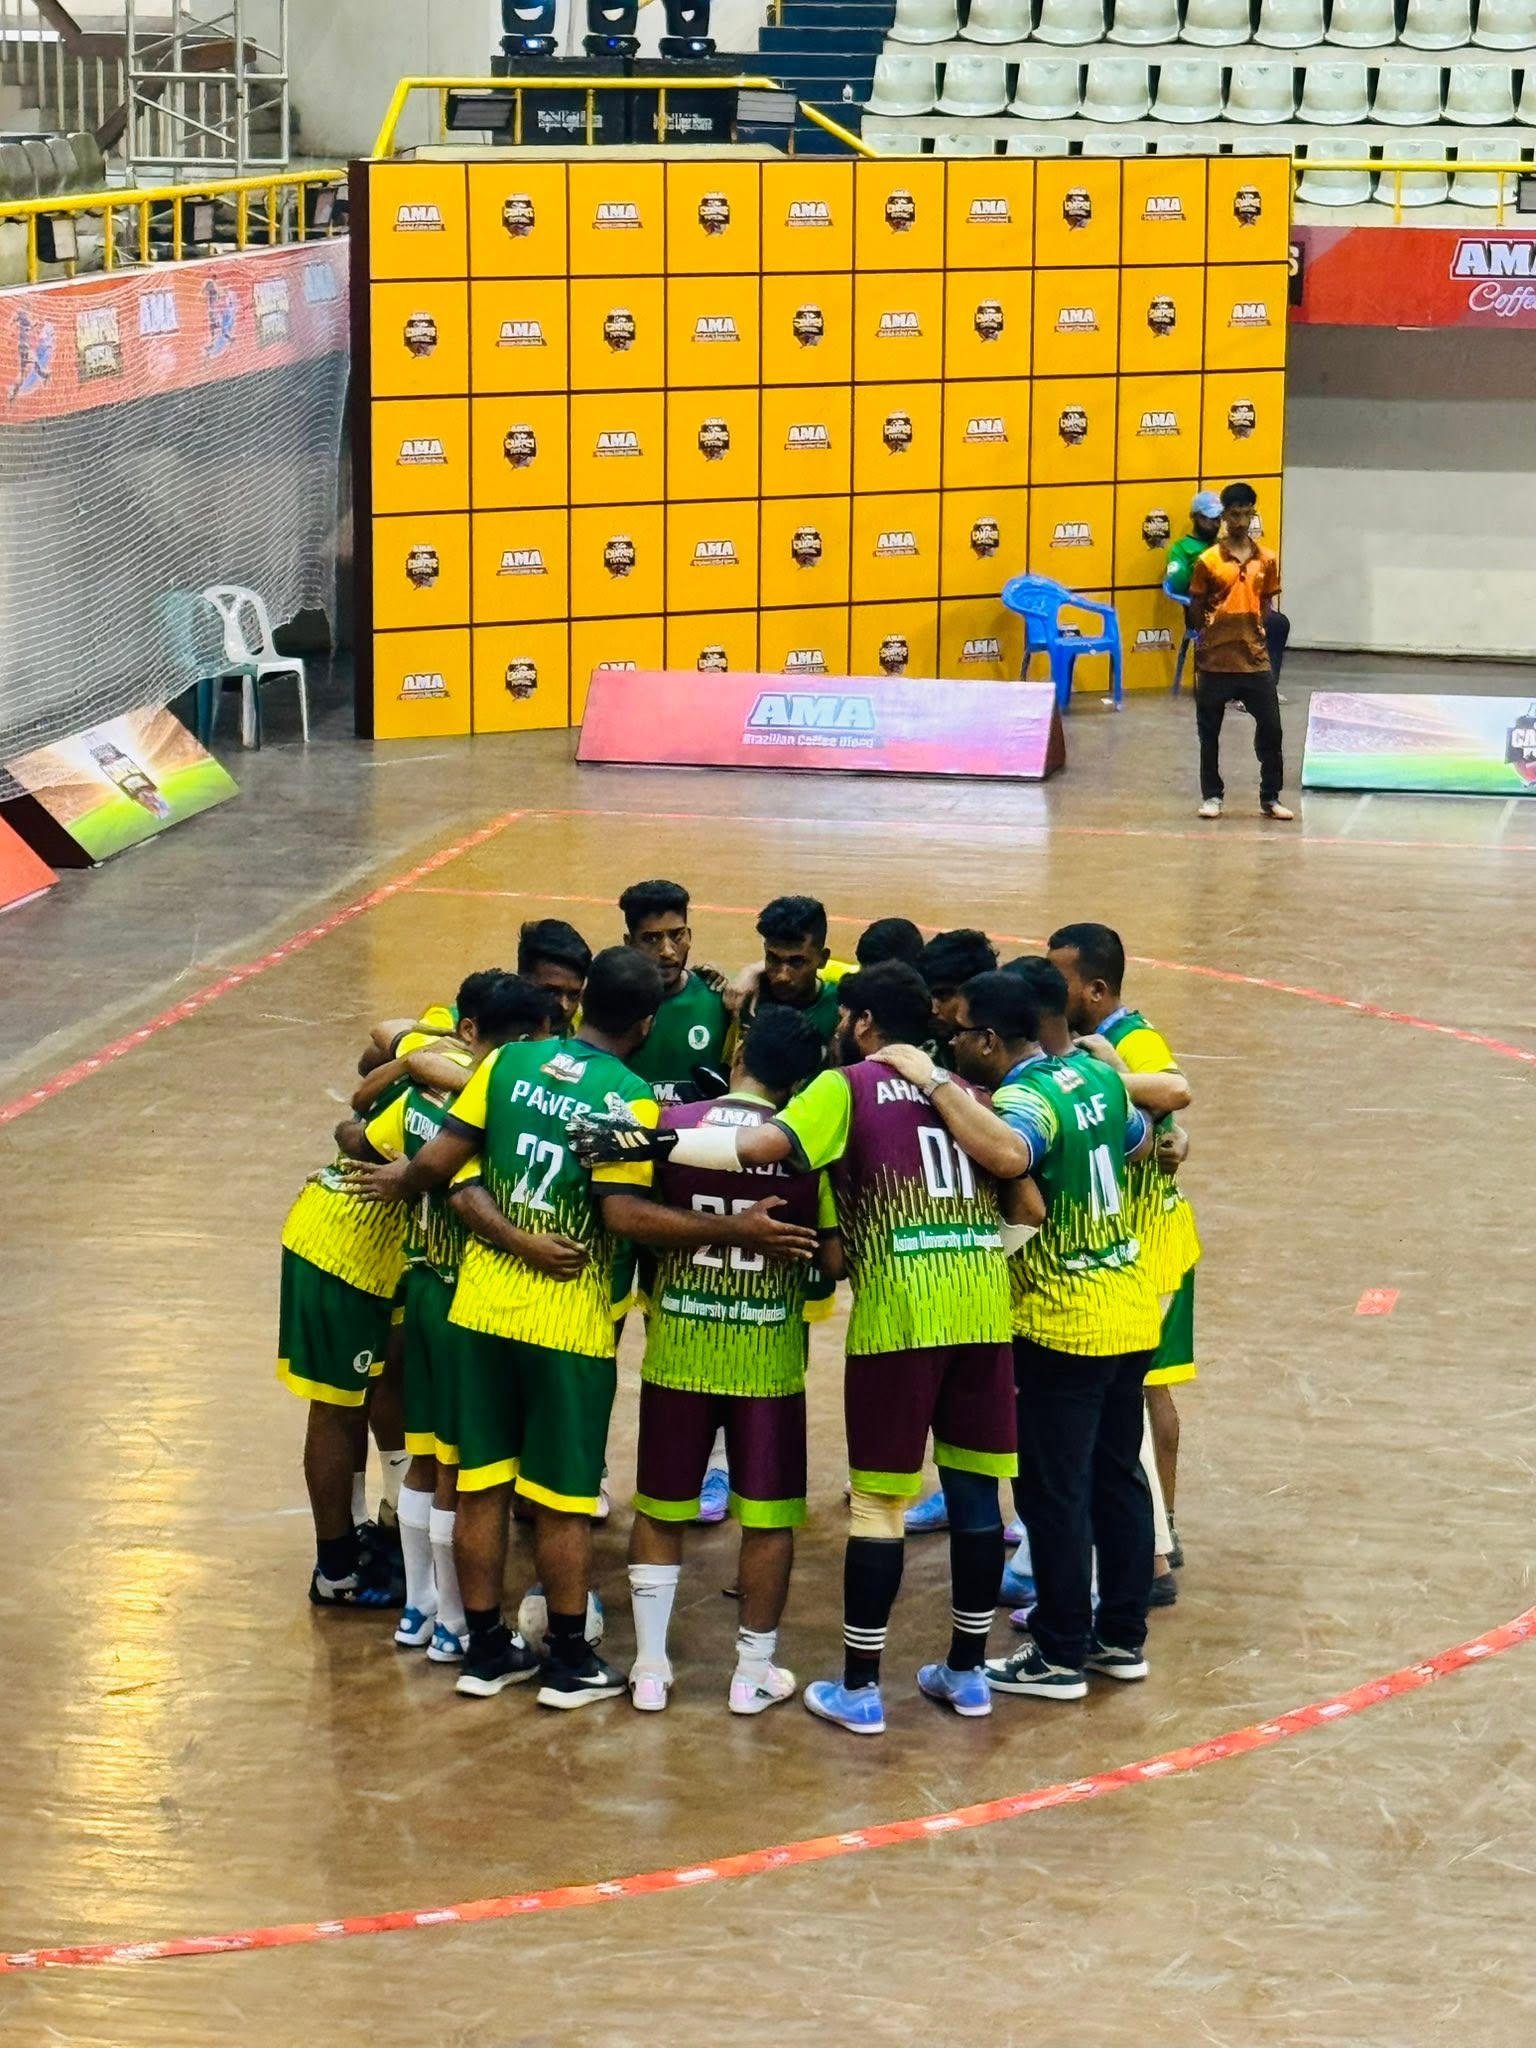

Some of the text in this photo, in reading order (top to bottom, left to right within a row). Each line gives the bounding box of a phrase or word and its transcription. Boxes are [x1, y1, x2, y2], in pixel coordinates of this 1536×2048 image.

[398, 206, 440, 221] AMA
[597, 204, 638, 220] AMA
[789, 203, 828, 218] AMA
[971, 200, 1007, 213] AMA
[1146, 198, 1180, 213] AMA
[1455, 243, 1536, 275] AM
[1469, 282, 1536, 317] Coffe
[1059, 309, 1094, 325] AMA
[1232, 304, 1266, 320] AMA
[501, 322, 541, 338] AMA
[696, 318, 734, 334] AMA
[881, 314, 918, 330] AMA
[967, 419, 1003, 435] AMA
[1142, 413, 1176, 426] AMA
[598, 433, 637, 449] AMA
[789, 426, 826, 442] AMA
[401, 440, 443, 455] AMA
[1054, 524, 1089, 537] AMA
[695, 541, 733, 557] AMA
[878, 533, 914, 549] AMA
[501, 551, 542, 567] AMA
[1137, 630, 1171, 643] AMA
[963, 640, 998, 653] AMA
[786, 651, 823, 667] AMA
[402, 674, 444, 690] AMA
[750, 695, 874, 729] AMA
[742, 733, 795, 745] Brazilian
[798, 734, 837, 747] Coffee
[704, 1107, 761, 1128] AMA
[510, 1132, 564, 1214] 22
[681, 1295, 727, 1322] University
[729, 1301, 739, 1319] of
